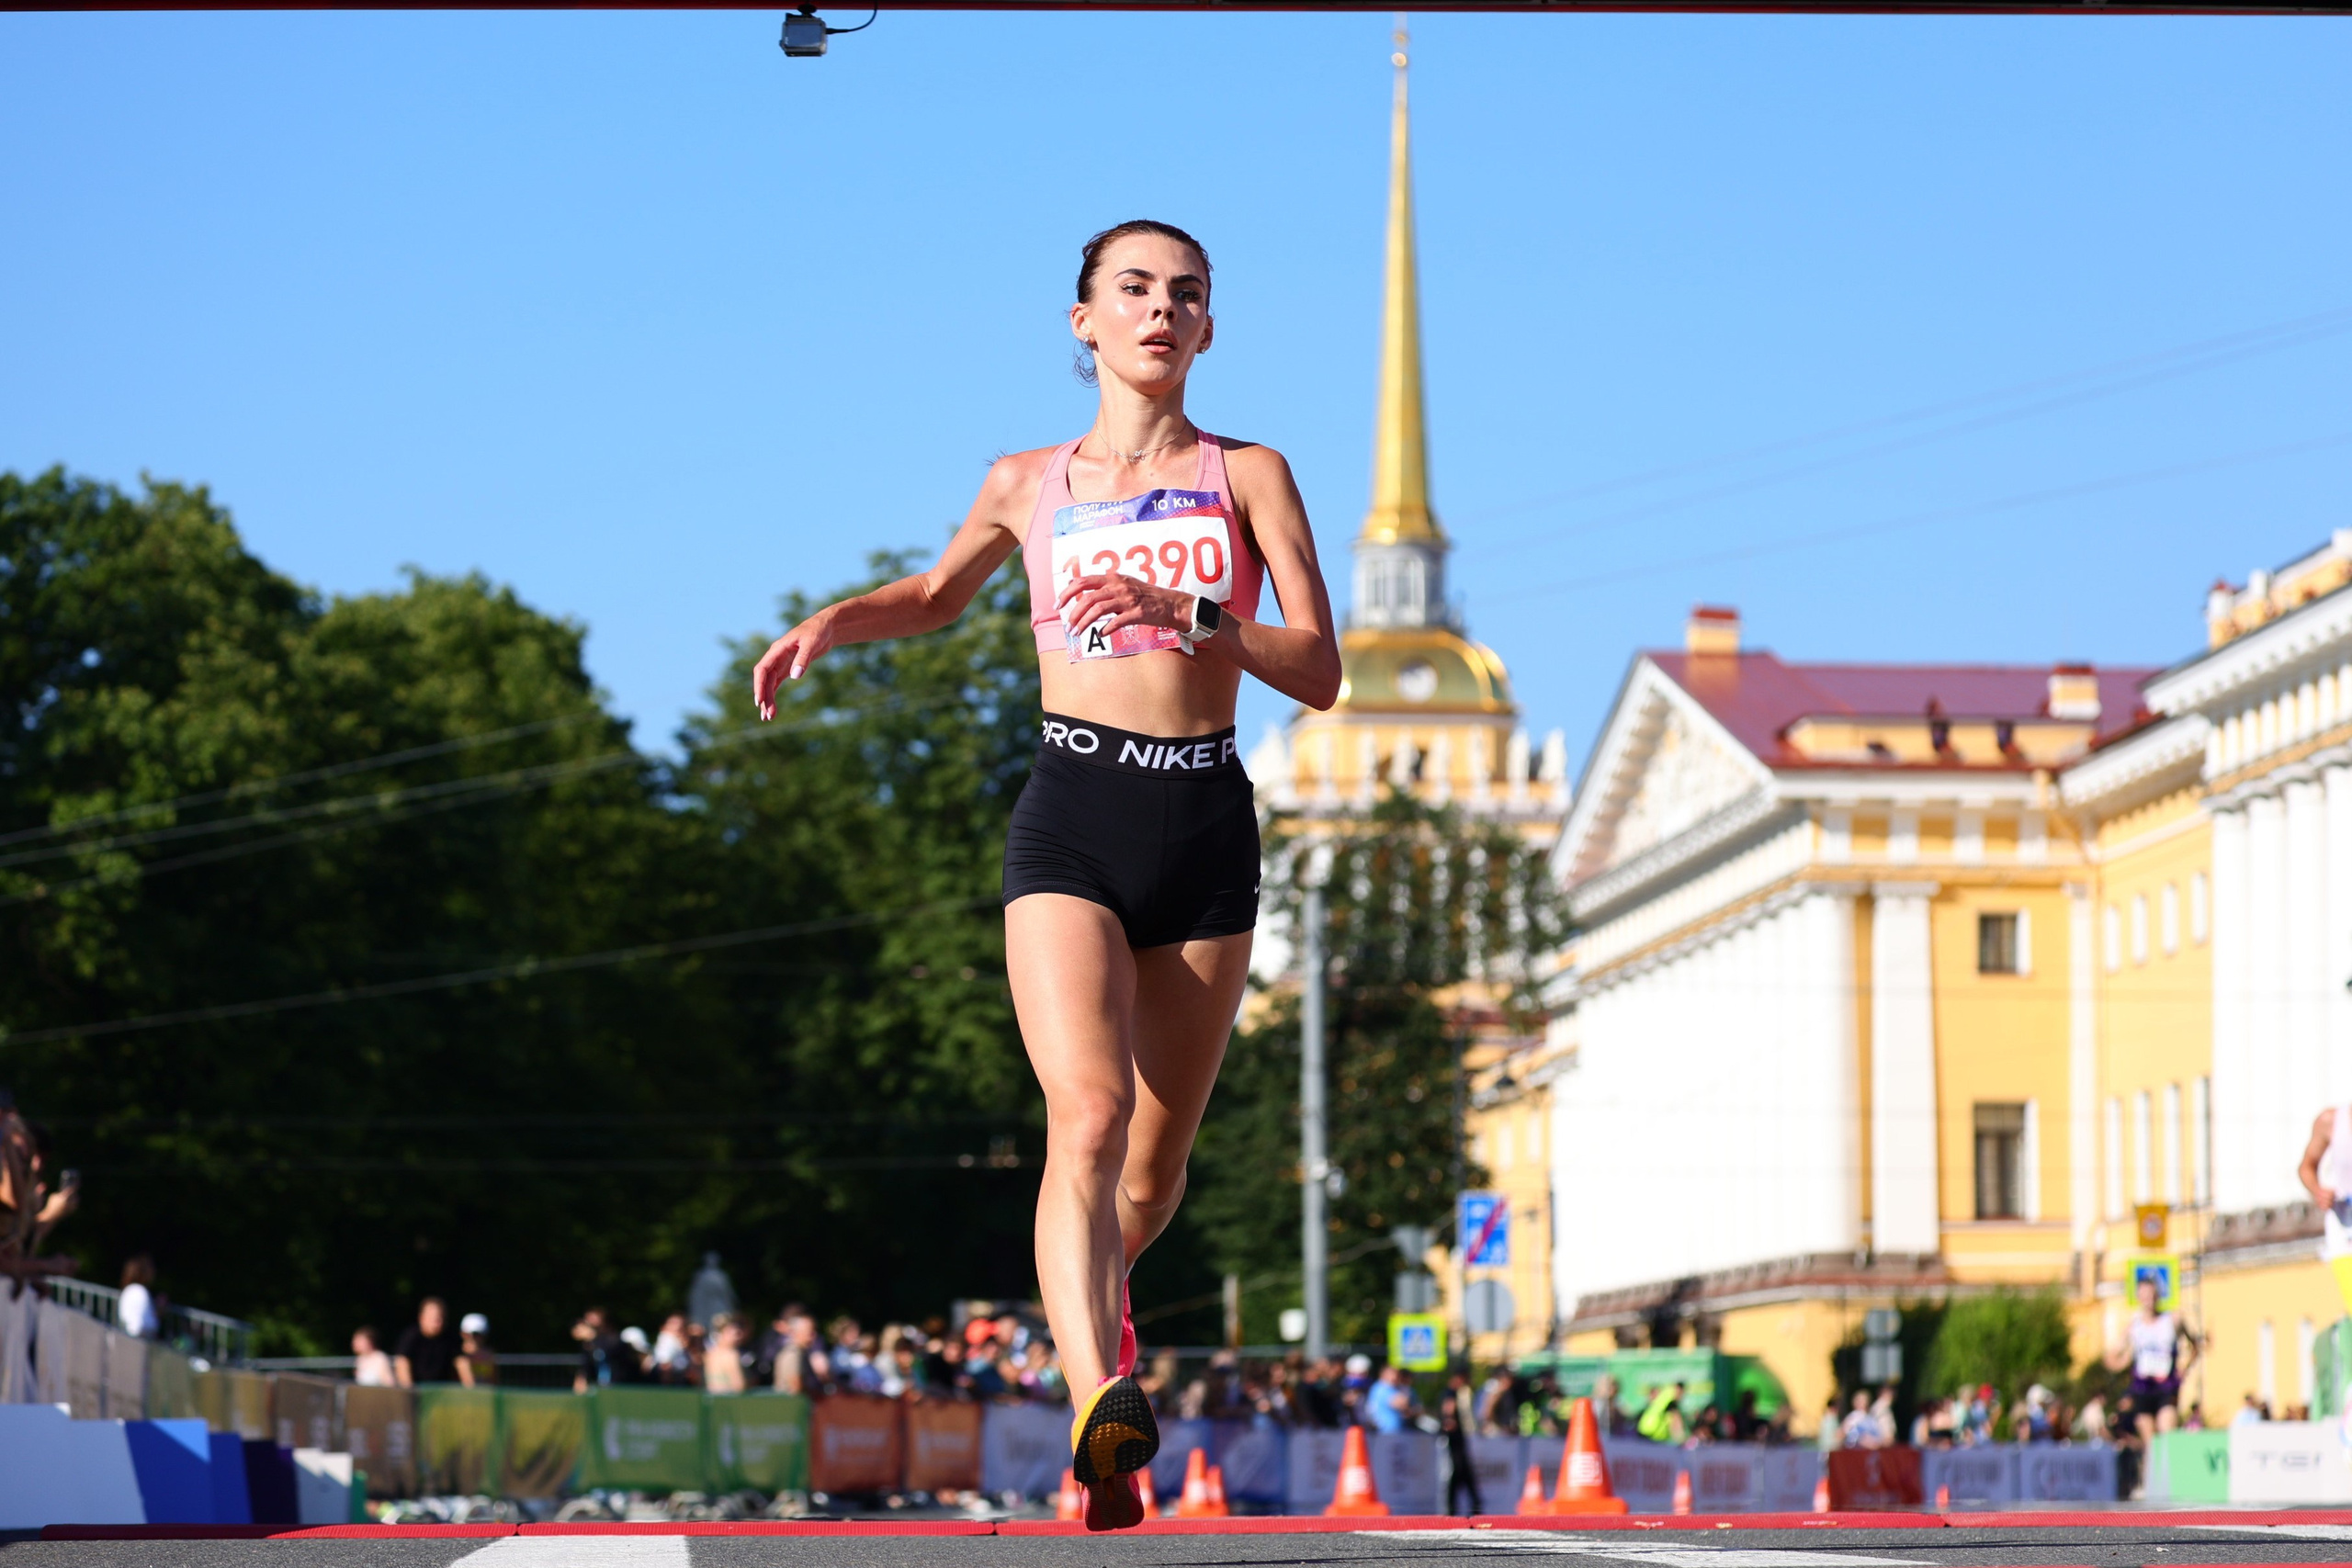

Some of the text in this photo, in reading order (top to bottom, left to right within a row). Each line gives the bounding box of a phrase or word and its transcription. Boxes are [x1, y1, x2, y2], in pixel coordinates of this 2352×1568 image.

[1073, 502, 1101, 515] ПОЛУ
[1151, 499, 1169, 512] 10
[1073, 504, 1124, 524] МАРАФОН
[1117, 739, 1216, 771] NIKE
[1221, 736, 1239, 764] P
